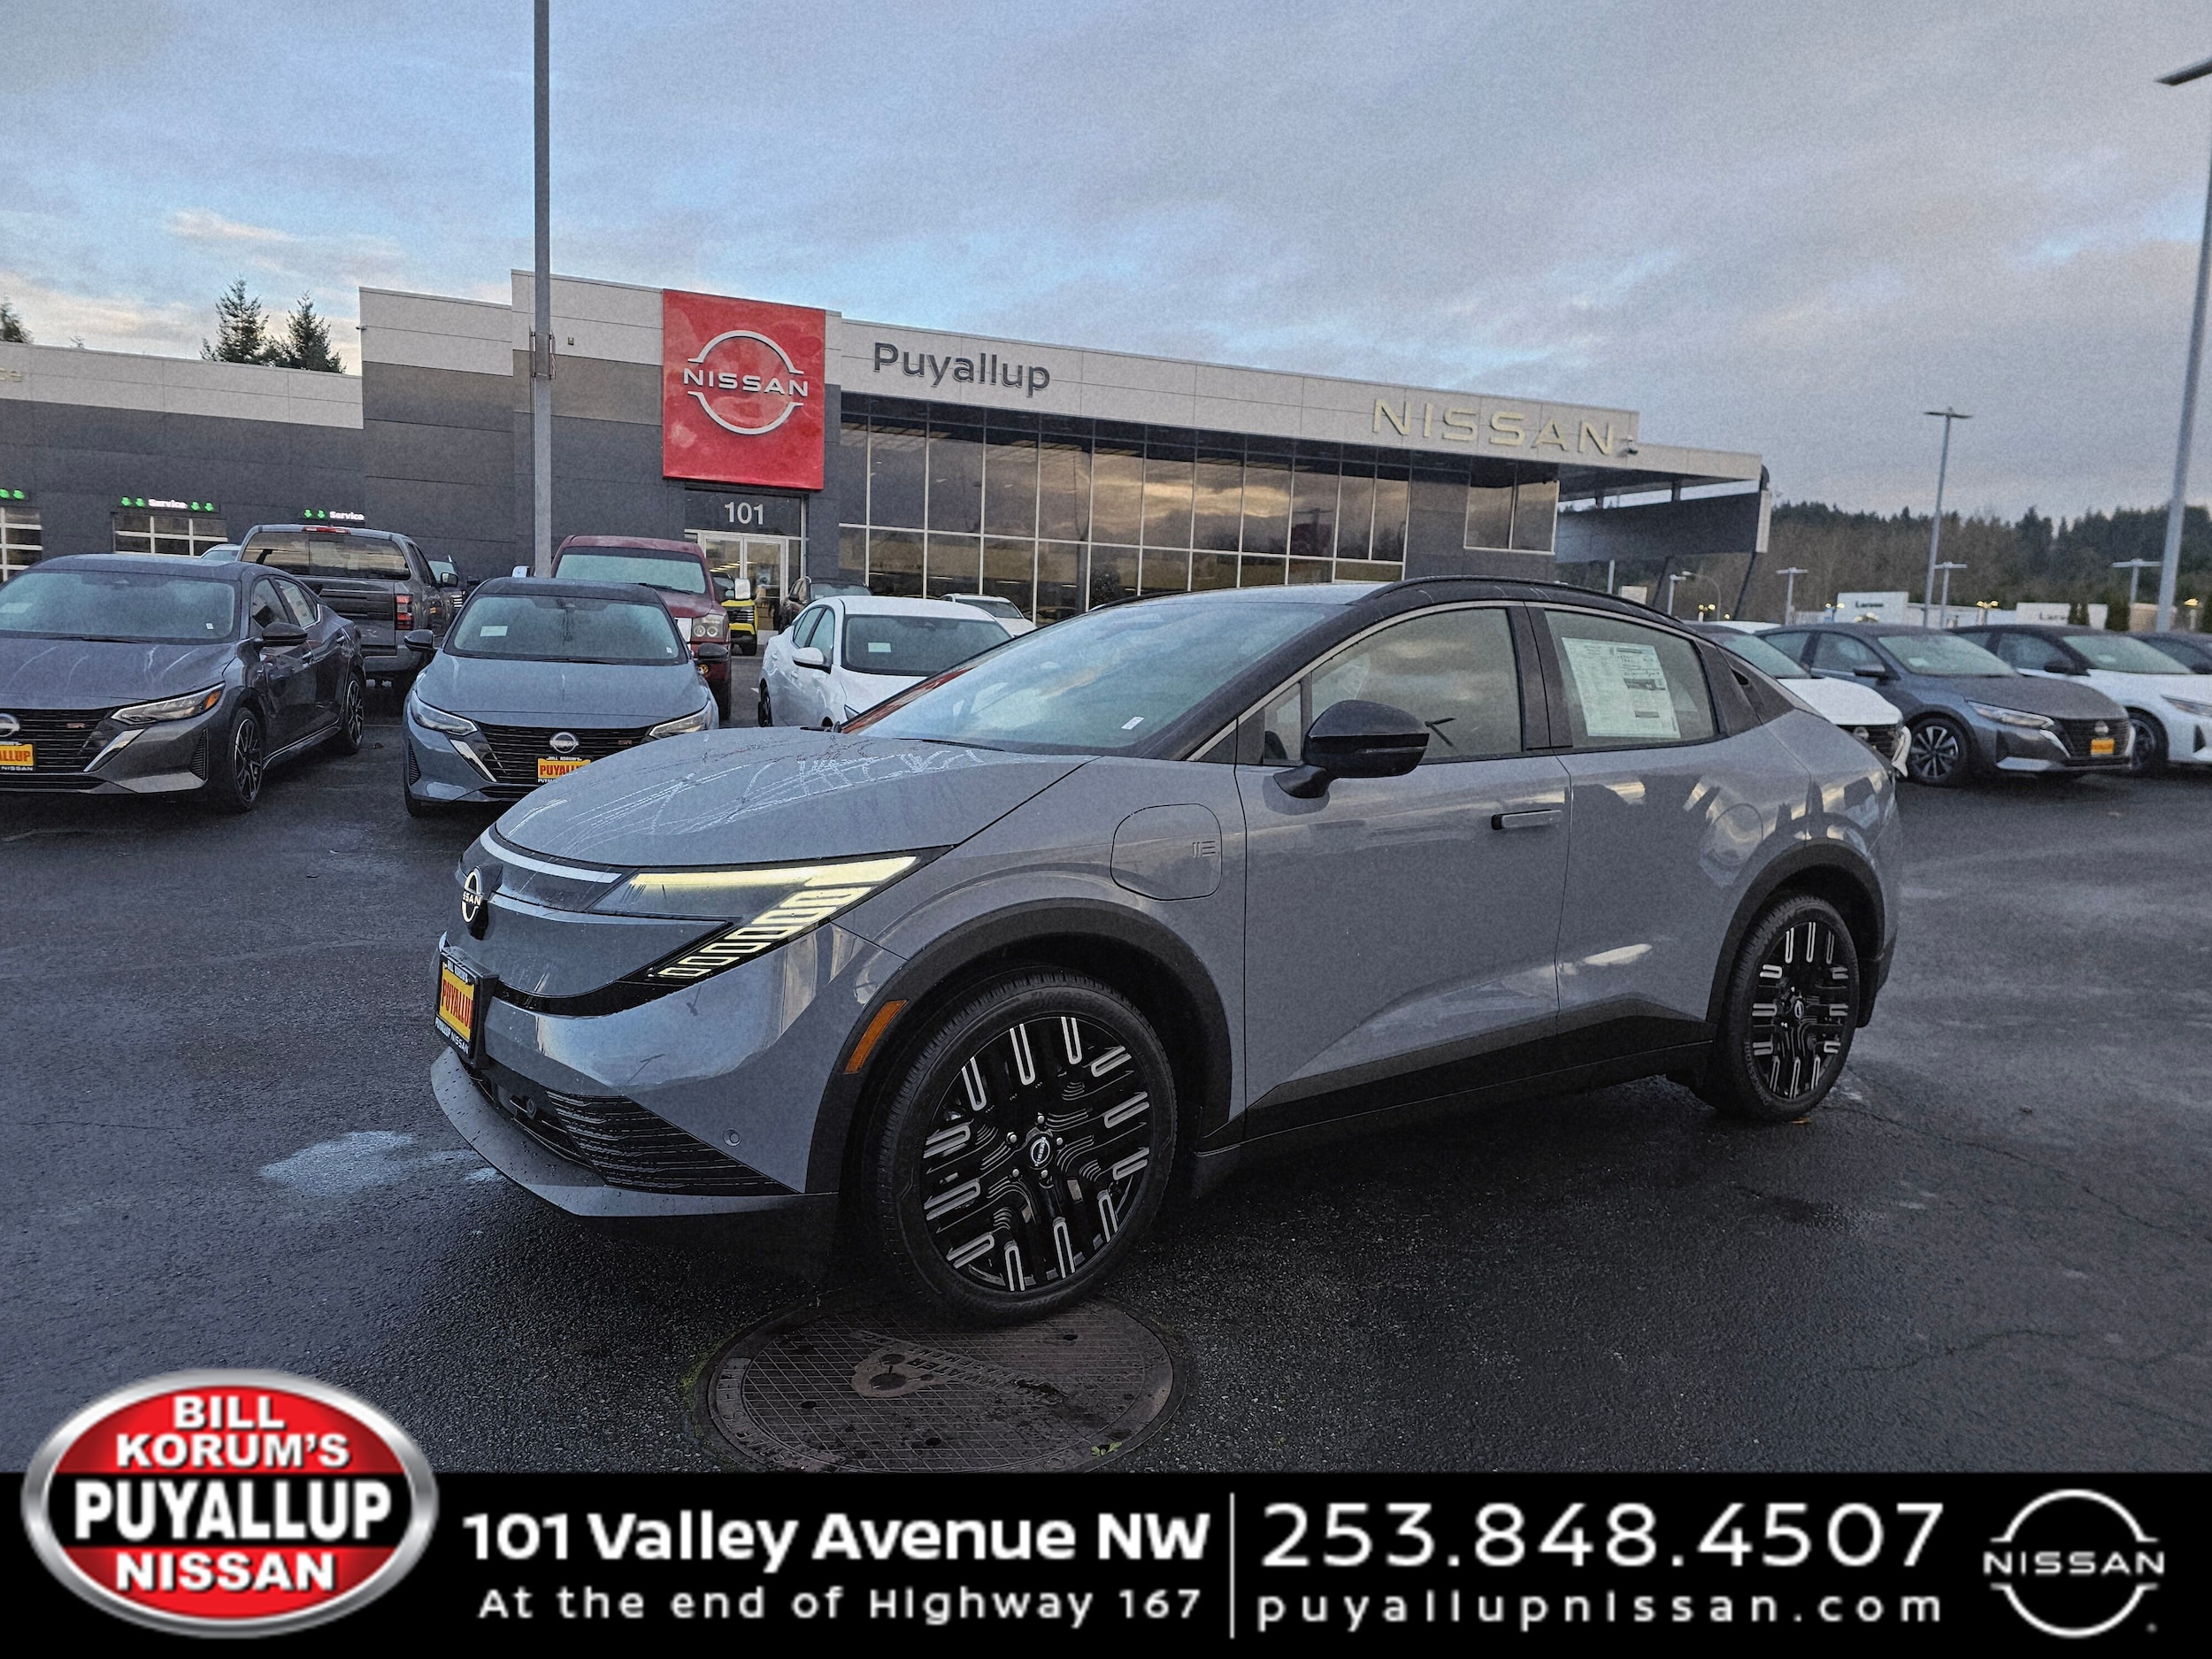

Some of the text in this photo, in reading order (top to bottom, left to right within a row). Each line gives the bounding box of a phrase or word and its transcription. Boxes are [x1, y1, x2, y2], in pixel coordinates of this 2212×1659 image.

[683, 367, 809, 398] NISSAN
[872, 342, 1051, 398] Puyallup
[1372, 397, 1615, 456] NISSAN
[148, 497, 188, 510] Service
[328, 511, 365, 521] Service
[723, 501, 764, 525] 101
